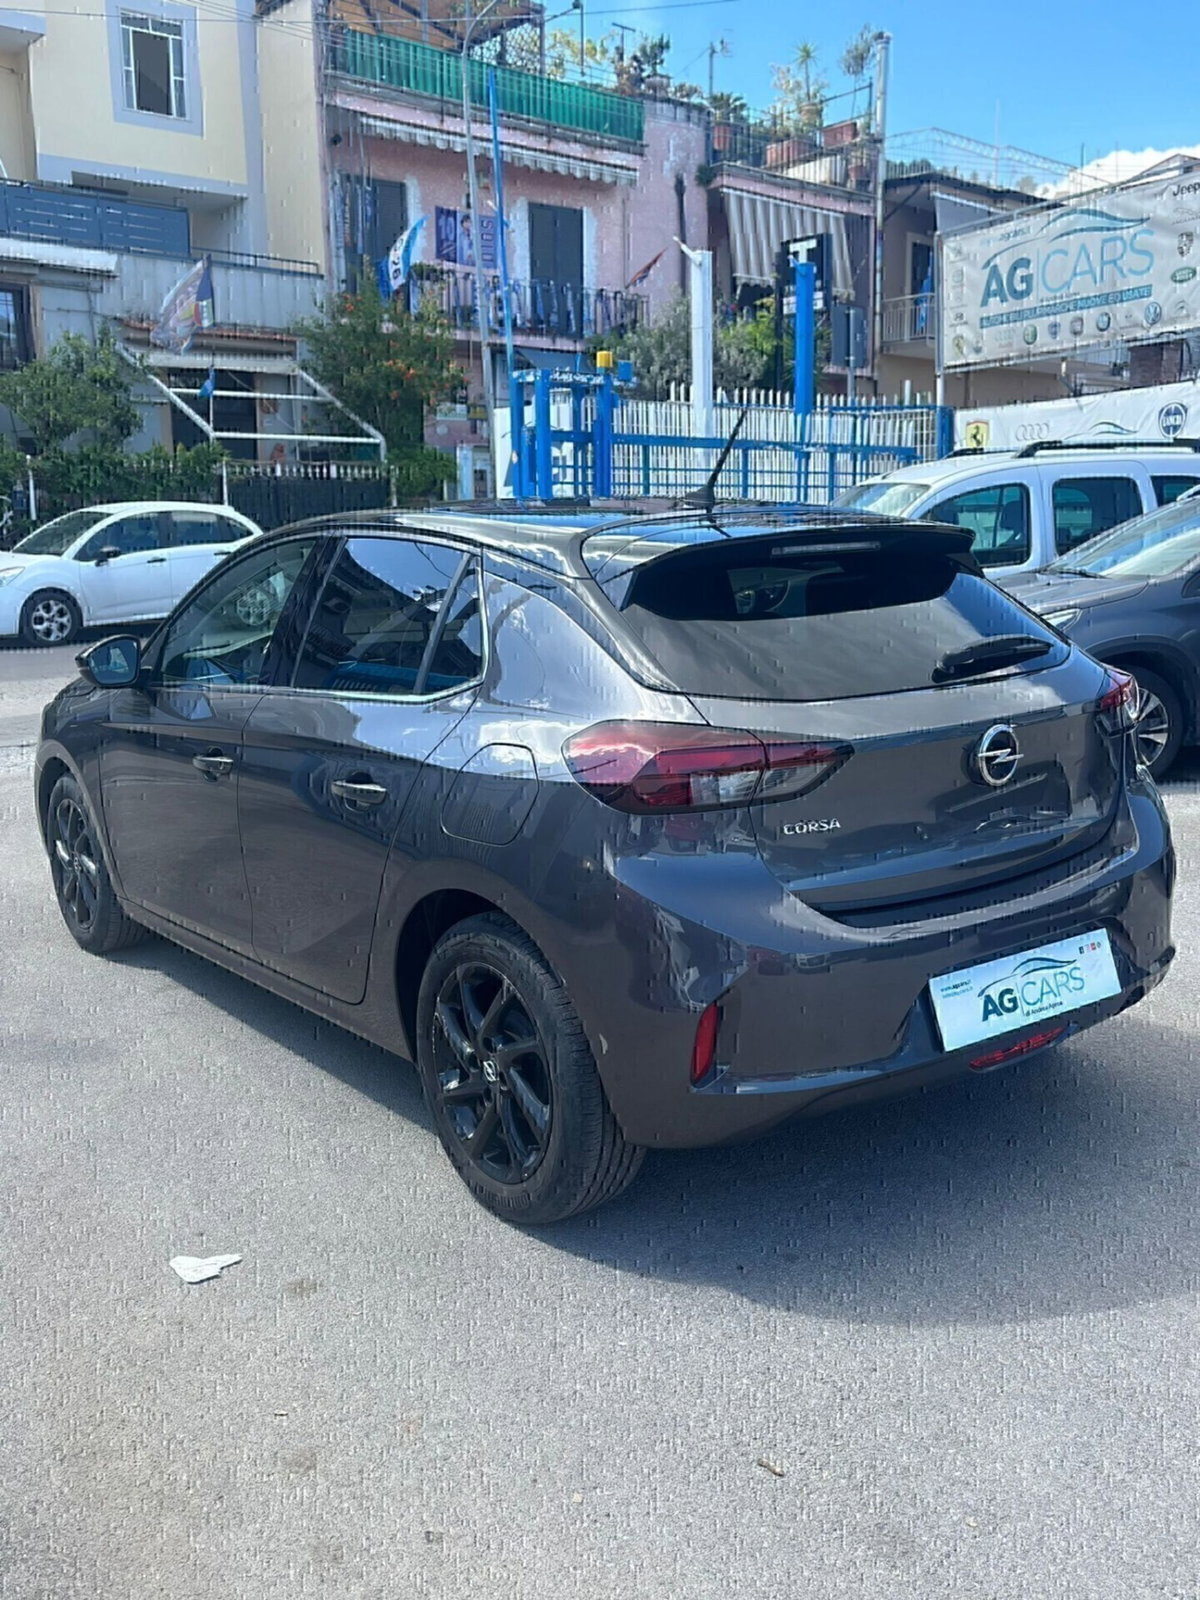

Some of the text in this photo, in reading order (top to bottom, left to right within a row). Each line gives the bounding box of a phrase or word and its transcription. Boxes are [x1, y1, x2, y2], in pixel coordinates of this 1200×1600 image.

[1172, 182, 1200, 197] Jeep
[979, 229, 1155, 307] AG CARS
[1122, 286, 1151, 301] USATE
[783, 818, 841, 835] CORSA
[982, 966, 1085, 1022] AG CARS
